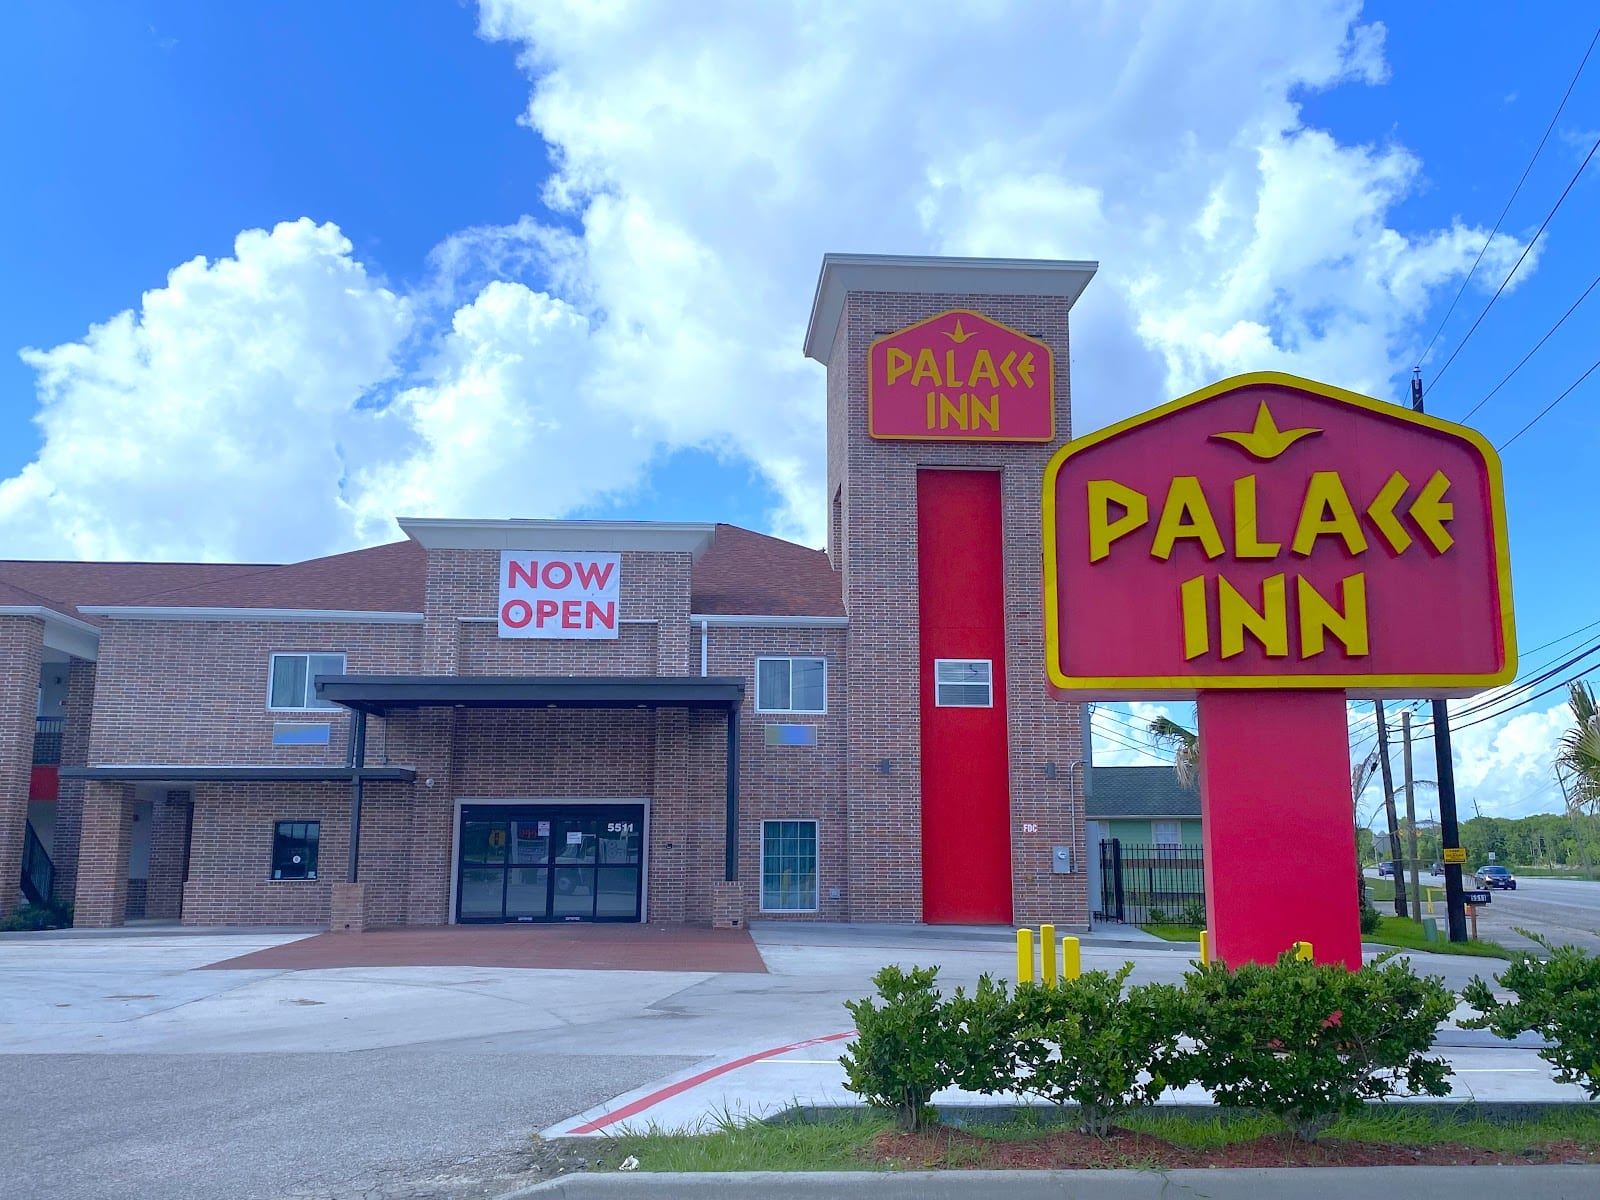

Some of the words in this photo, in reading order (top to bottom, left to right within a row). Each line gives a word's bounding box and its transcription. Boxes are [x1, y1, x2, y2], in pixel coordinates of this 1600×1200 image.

[887, 347, 1035, 388] PALACE
[926, 391, 1000, 431] INN
[1087, 470, 1455, 563] PALACE
[508, 560, 615, 590] NOW
[501, 599, 615, 629] OPEN
[1181, 572, 1369, 661] INN
[607, 822, 634, 833] 5511
[1023, 823, 1038, 833] FDC
